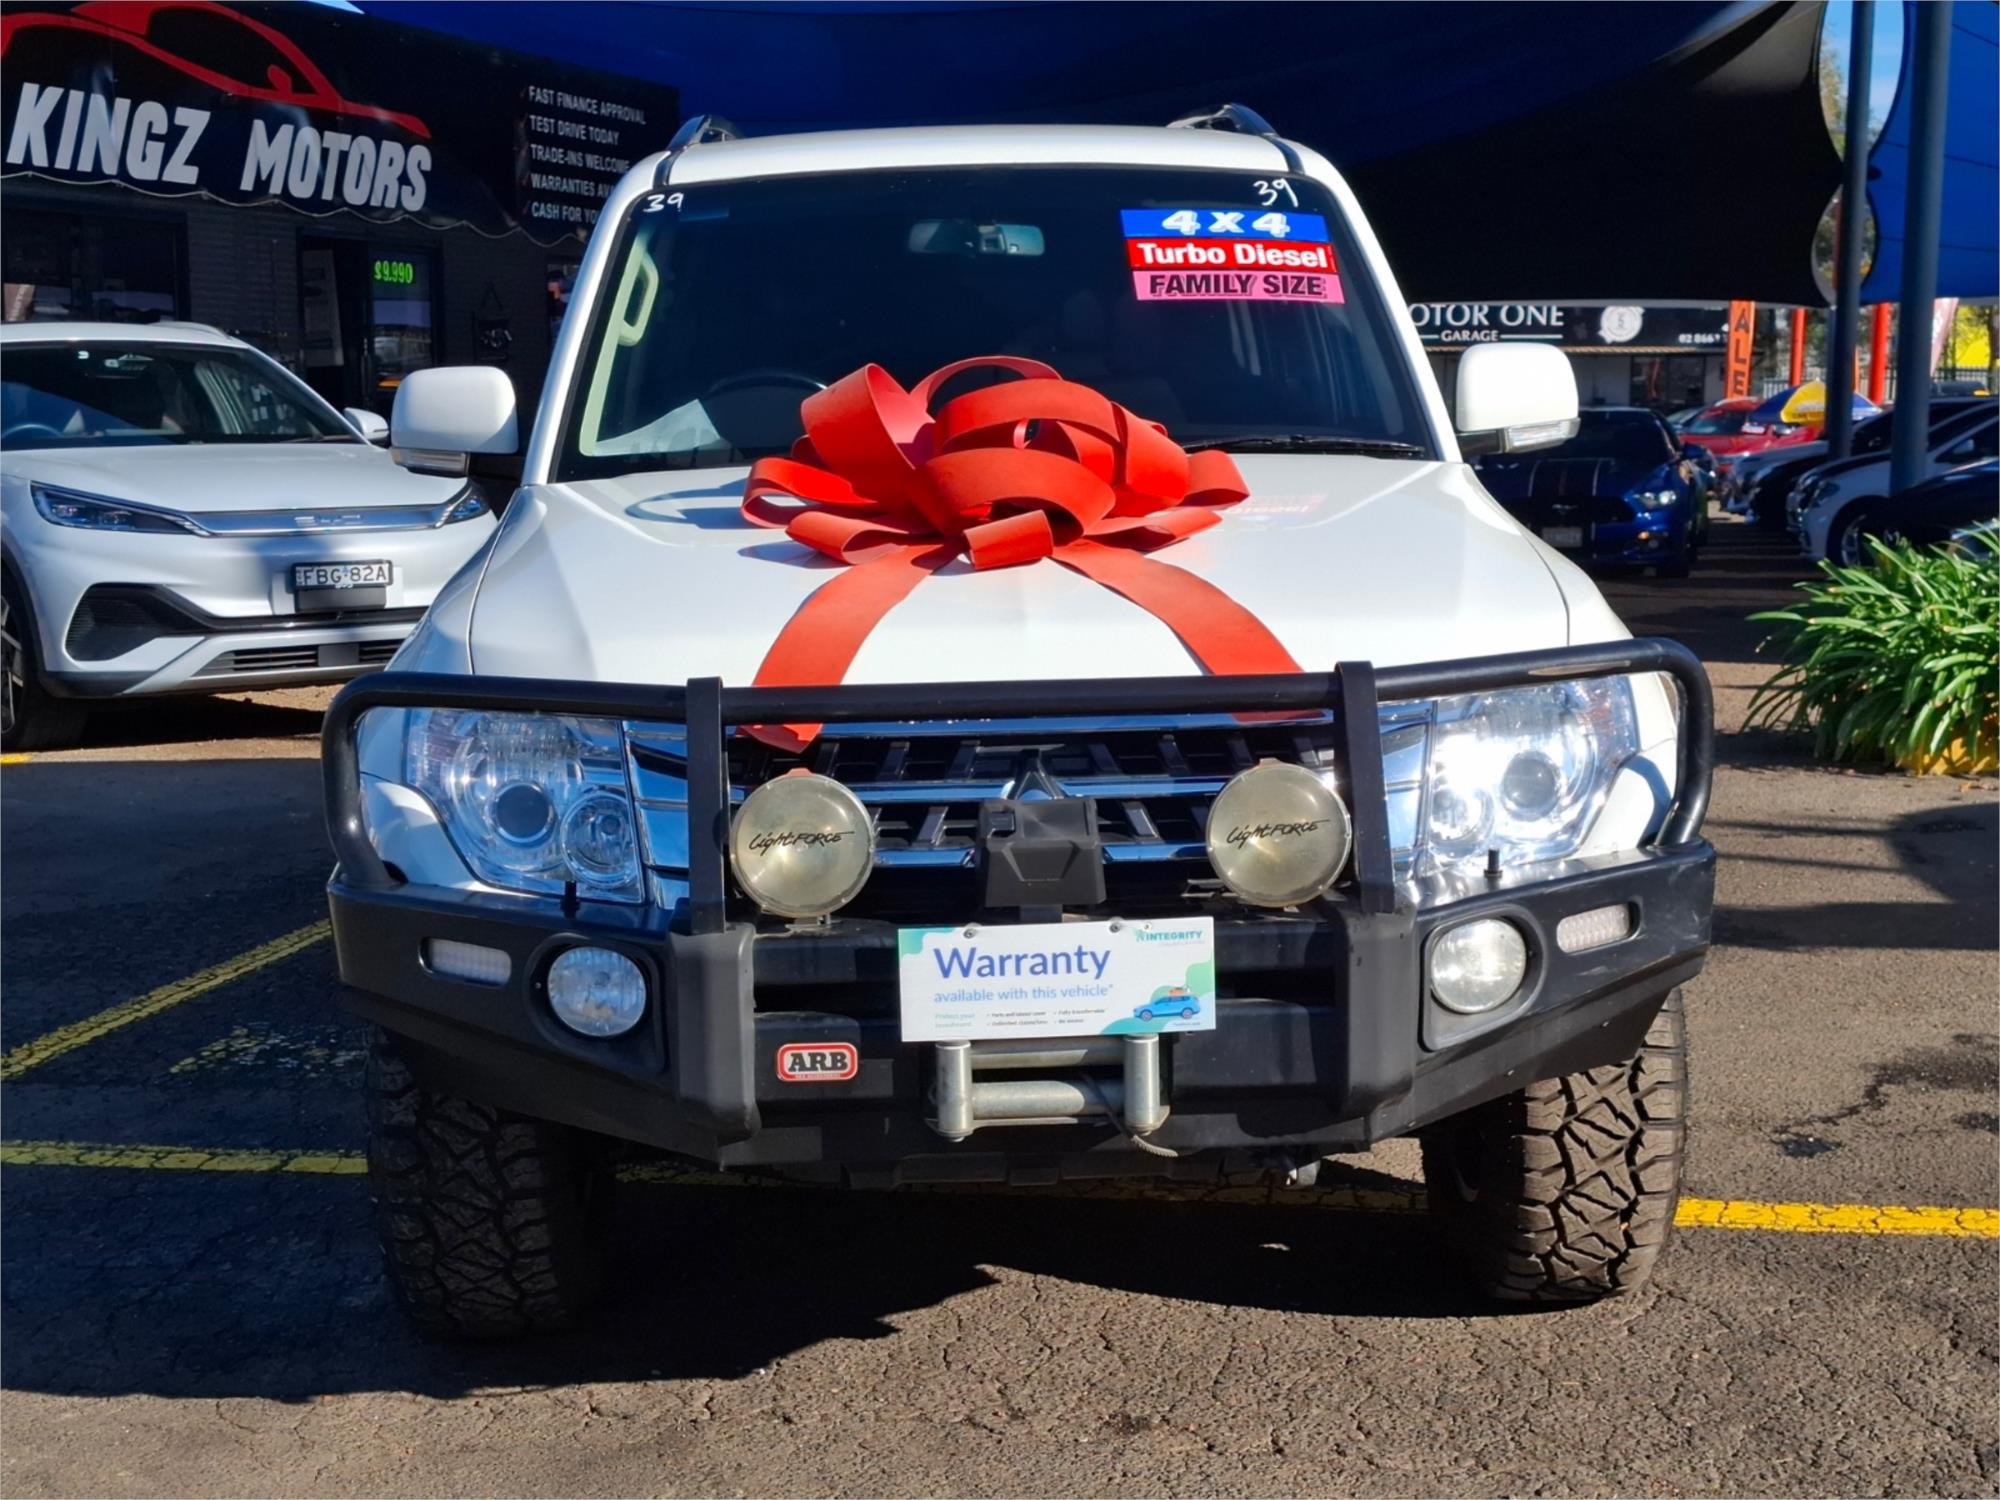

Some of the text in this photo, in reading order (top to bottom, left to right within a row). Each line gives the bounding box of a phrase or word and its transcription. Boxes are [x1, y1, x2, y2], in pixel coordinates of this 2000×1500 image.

[528, 86, 646, 125] FAST FINANCE APPROVAL
[529, 115, 620, 145] TEST DRIVE TODAY
[6, 82, 432, 211] KINGZ MOTORS
[530, 144, 584, 167] TRADE-INS
[531, 173, 596, 197] WARRANTIES
[1253, 178, 1298, 207] 39
[531, 202, 560, 220] CASH
[562, 206, 583, 223] FOR
[643, 192, 685, 212] 39
[1137, 243, 1328, 268] Turbo Diesel
[1150, 274, 1327, 298] FAMILY SIZE
[1407, 303, 1564, 326] OTOR ONE
[1440, 330, 1499, 341] GARAGE
[1733, 307, 1750, 396] ALE
[1146, 930, 1203, 941] INTEGRITY
[933, 945, 1111, 980] Warranty
[934, 987, 993, 1004] available
[997, 985, 1029, 1001] with
[1032, 985, 1057, 1000] this
[787, 1051, 848, 1072] ARB
